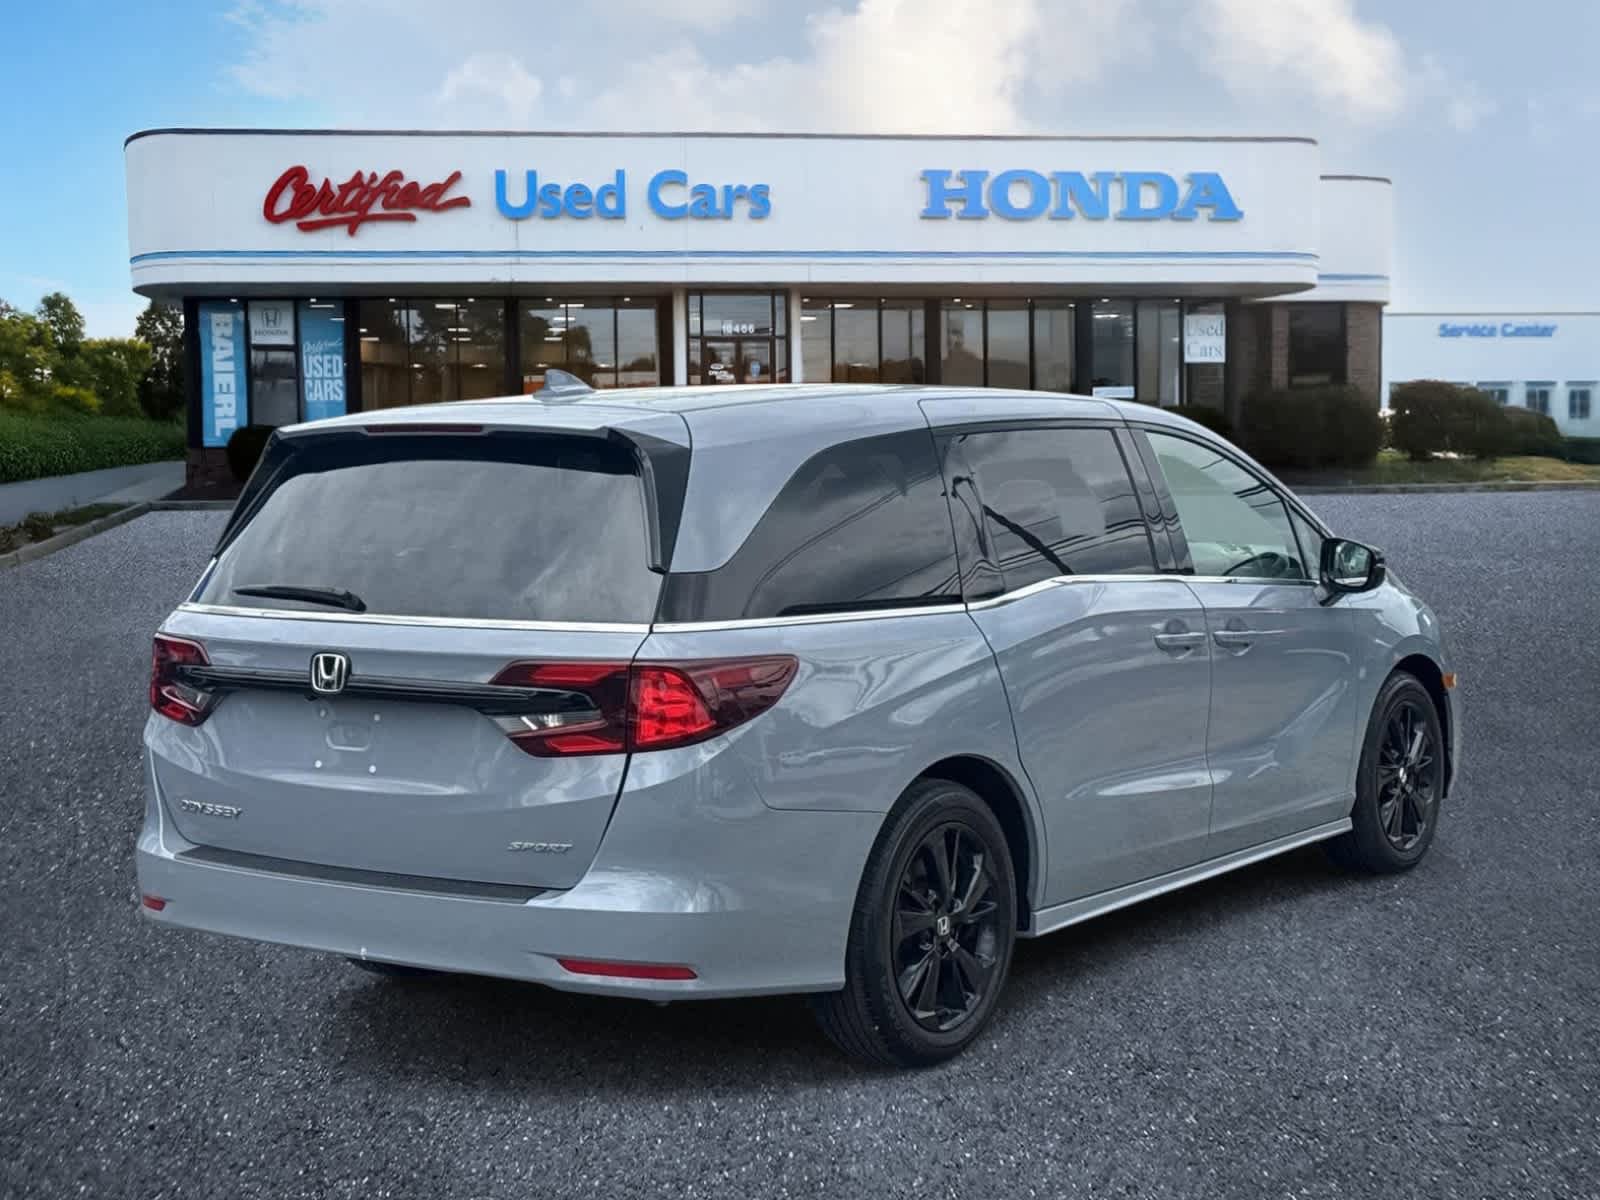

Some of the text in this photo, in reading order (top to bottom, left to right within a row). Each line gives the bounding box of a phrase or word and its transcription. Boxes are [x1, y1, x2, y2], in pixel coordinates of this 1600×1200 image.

[263, 165, 772, 235] Certified Used Cars
[920, 169, 1244, 221] HONDA
[254, 328, 289, 337] HONDA
[1186, 319, 1225, 338] Used
[1438, 322, 1558, 338] Service Center
[1186, 343, 1224, 358] Cars
[210, 313, 239, 437] BAIERL
[303, 355, 344, 378] USED
[304, 379, 345, 402] CARS
[180, 798, 243, 821] ODYSSEY
[506, 839, 574, 855] SPORT
